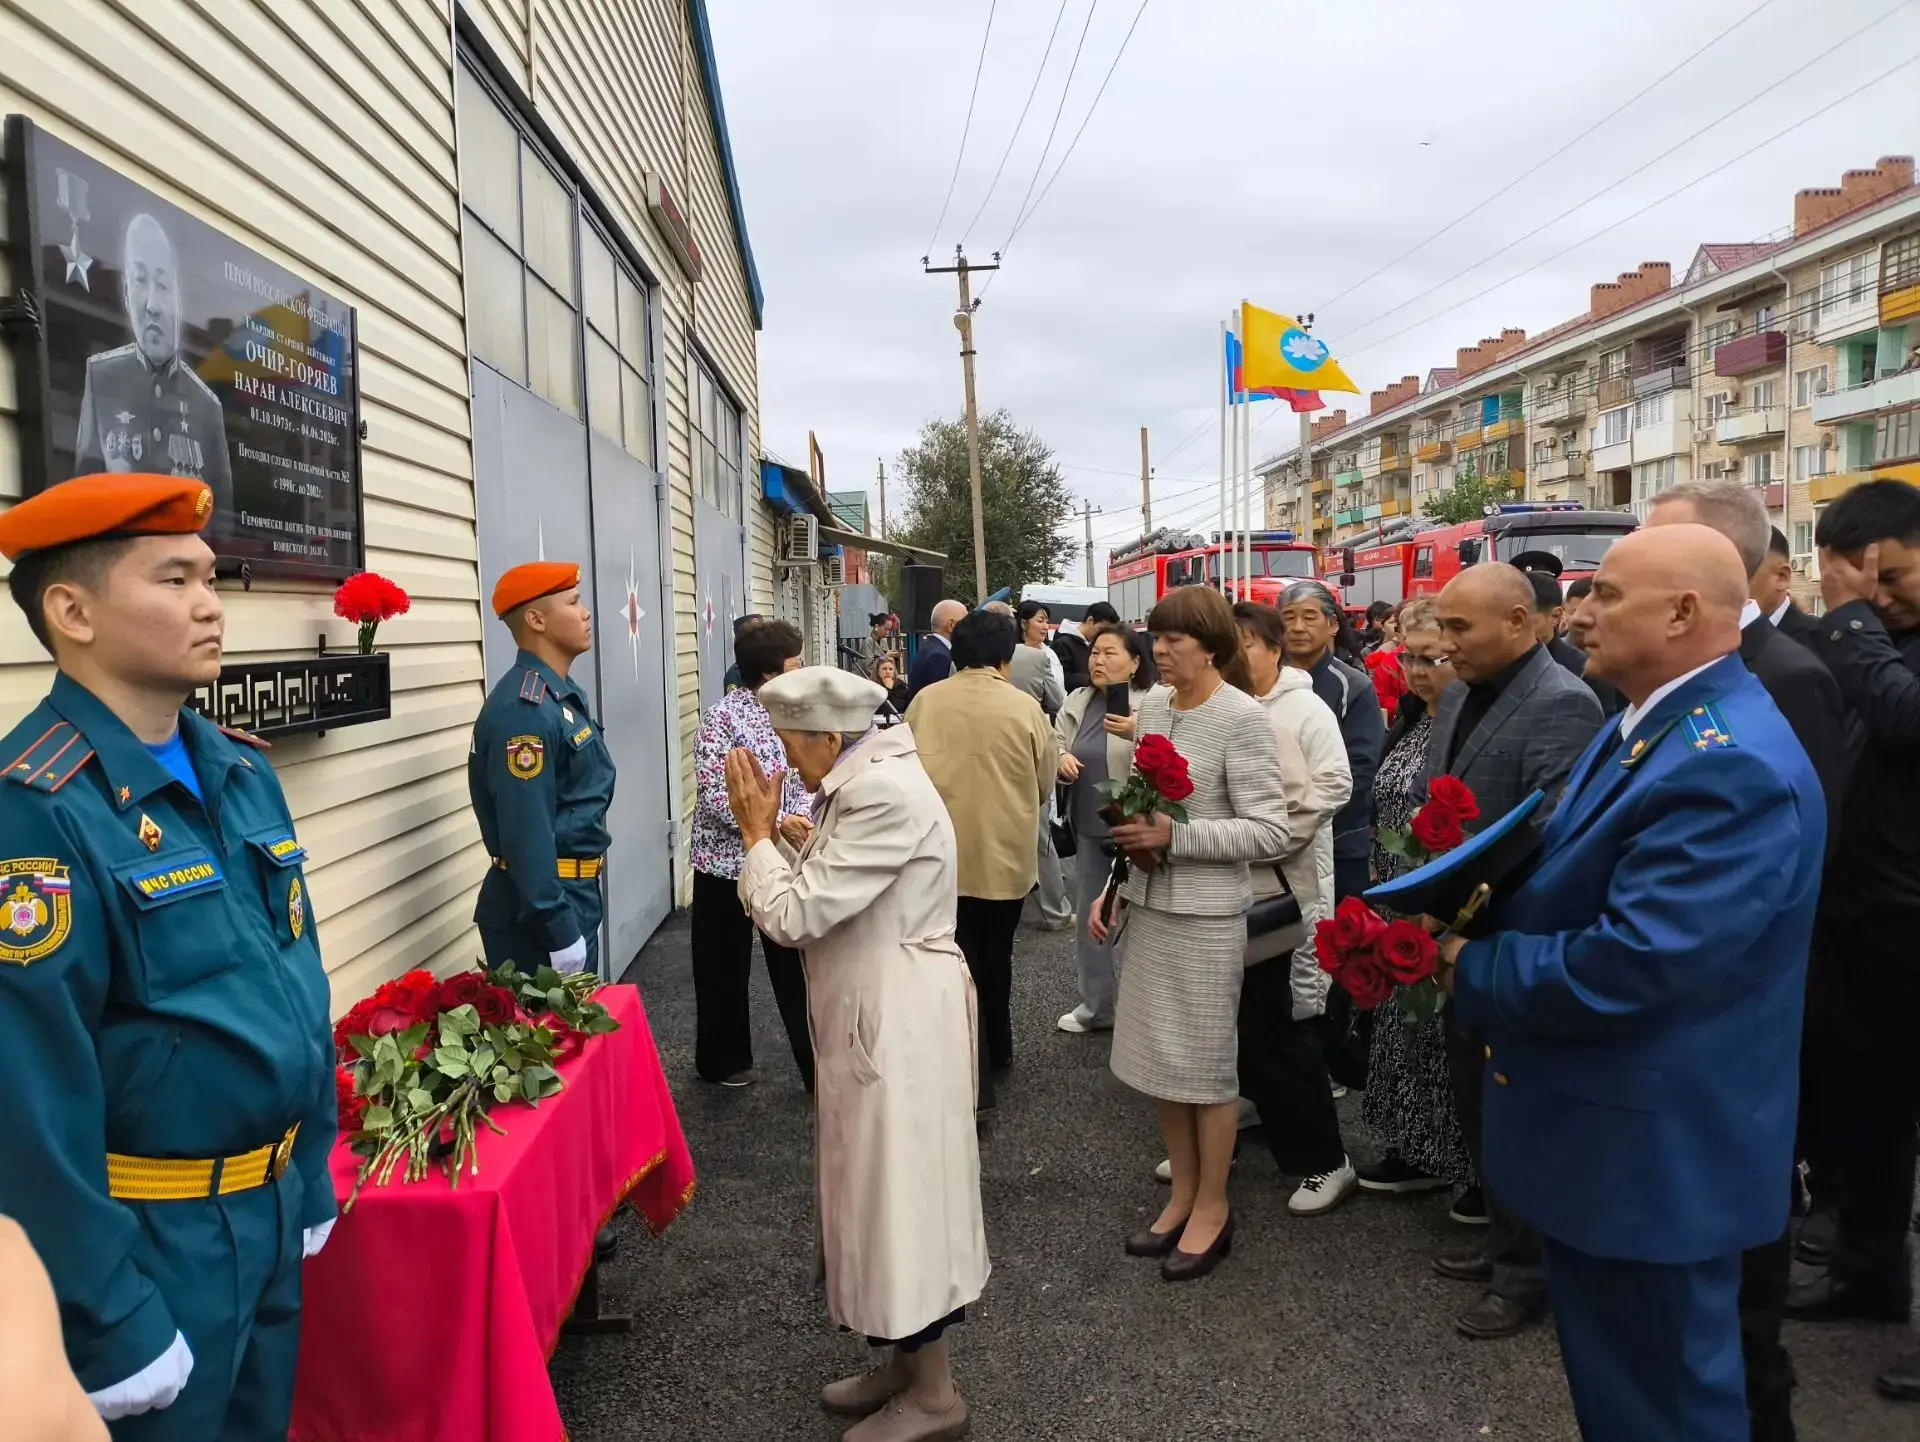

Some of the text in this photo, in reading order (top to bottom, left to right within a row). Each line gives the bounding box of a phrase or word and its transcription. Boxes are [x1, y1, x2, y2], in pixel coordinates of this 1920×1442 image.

[224, 261, 348, 338] ГЕРОЙ РОССИЙСКОЙ ФЕДЕРАЦИИ
[246, 340, 338, 396] ОЧИР-ГОРЯЕВ
[234, 371, 348, 427] НАРАН АЛЕКСЕЕВИЧ
[0, 861, 53, 875] ЧС РОССИИ
[139, 863, 215, 894] МЧС РОССИИ
